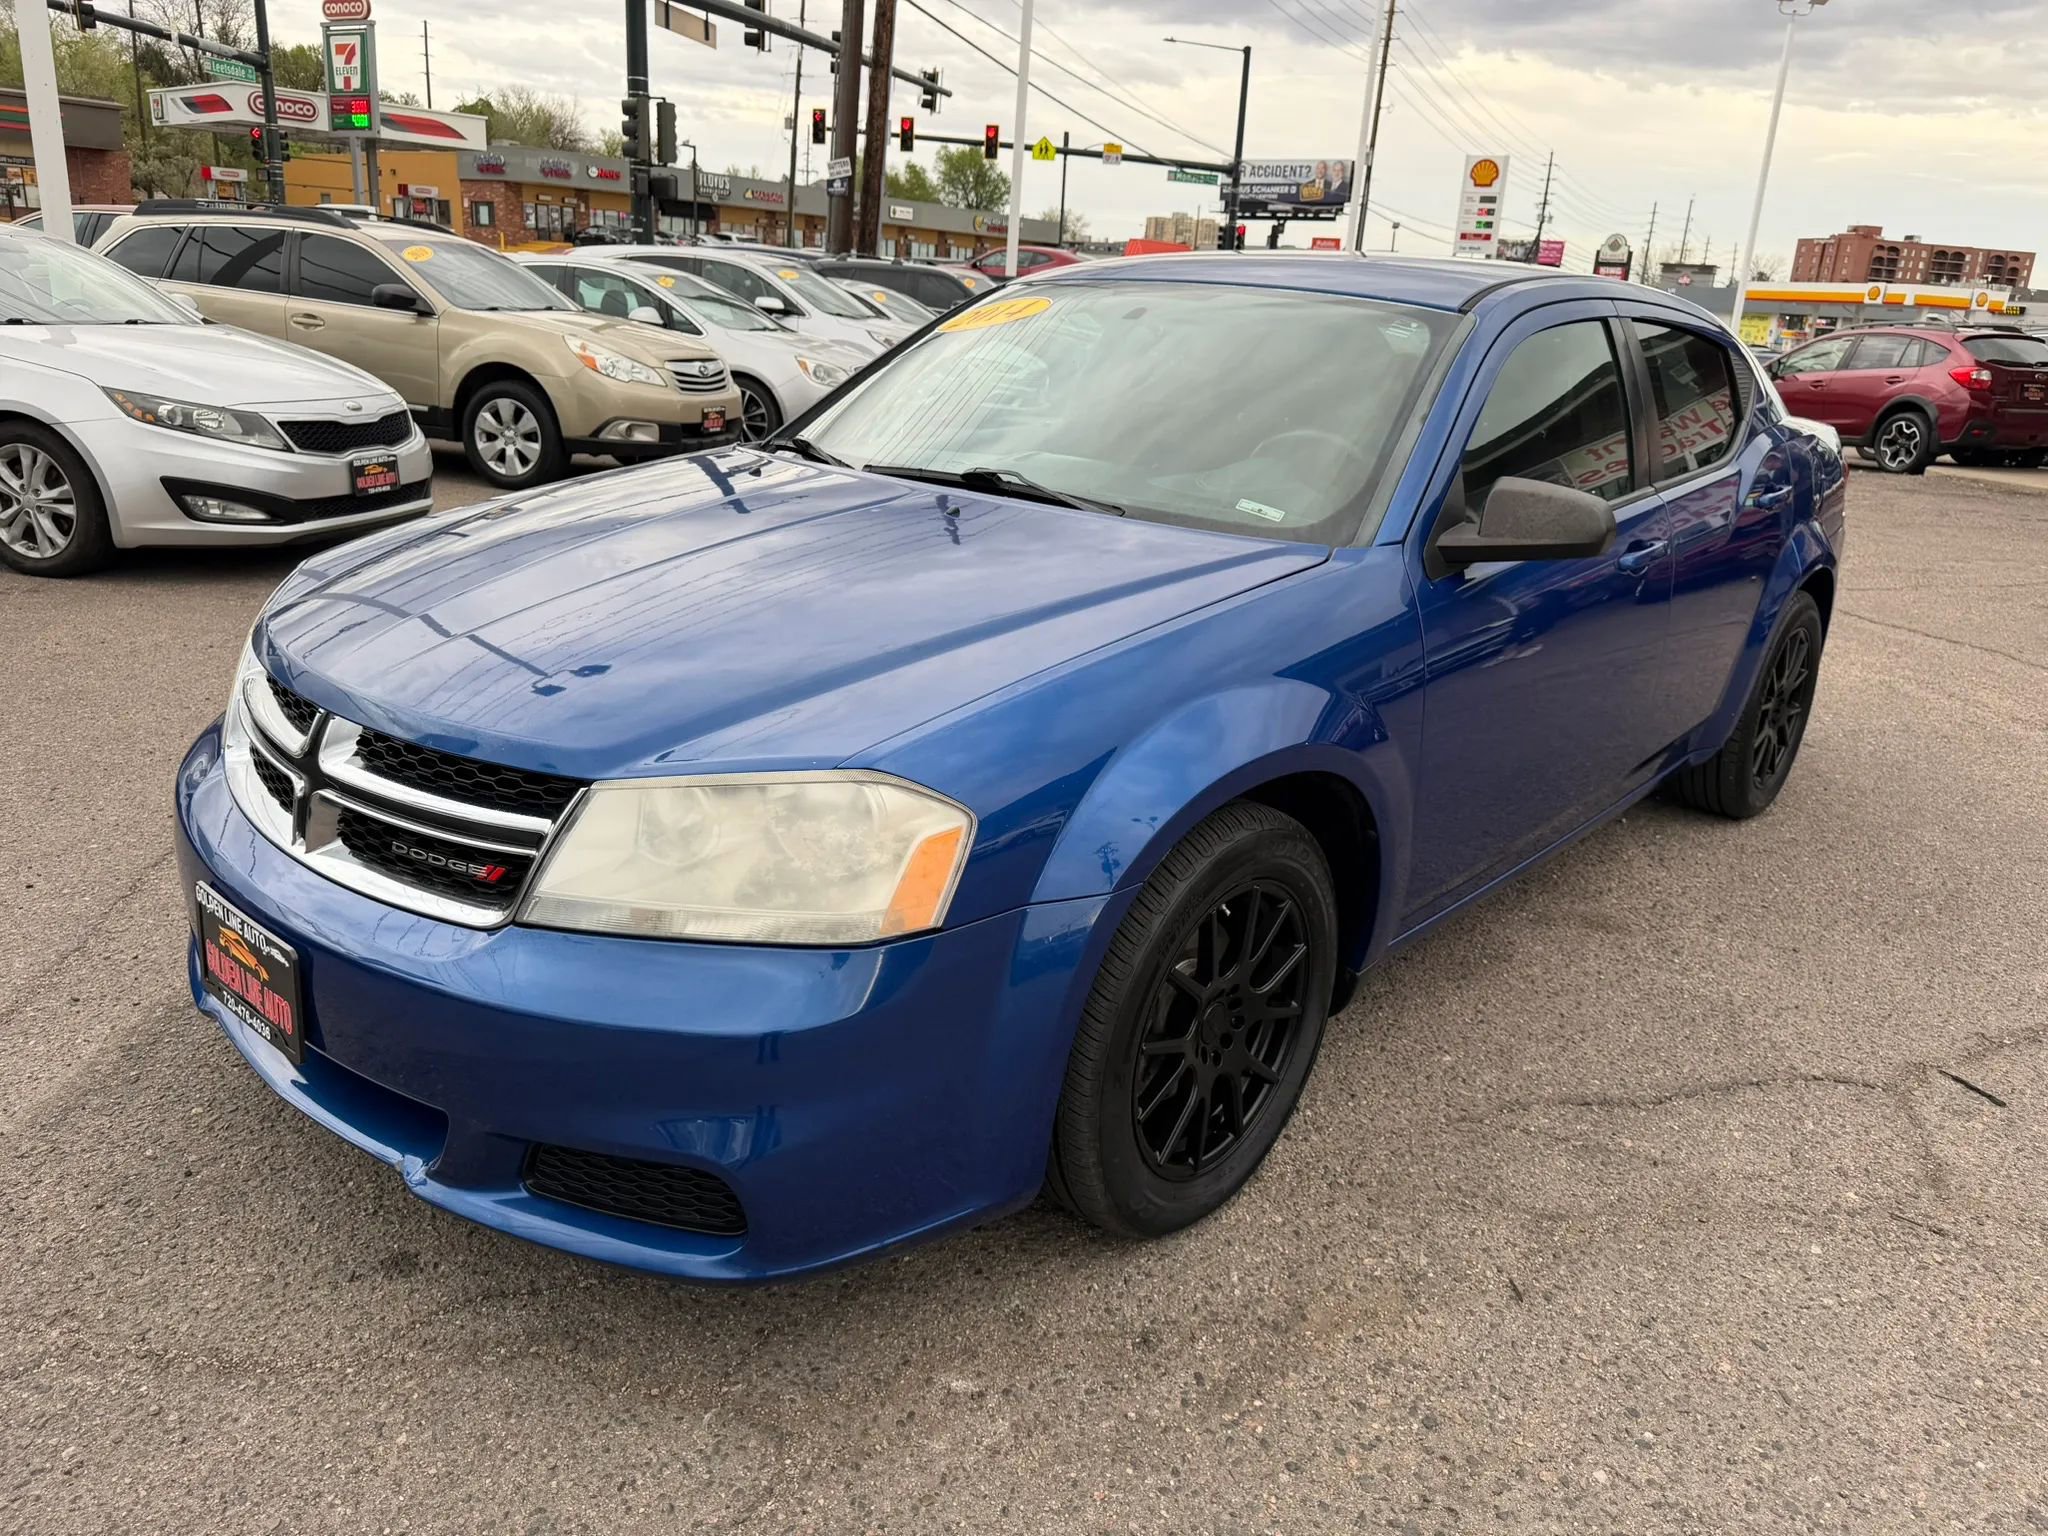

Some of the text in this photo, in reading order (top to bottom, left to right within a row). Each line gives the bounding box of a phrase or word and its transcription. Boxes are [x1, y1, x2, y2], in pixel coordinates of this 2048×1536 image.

[256, 100, 314, 116] cnoco
[1249, 165, 1312, 178] ACCIDENT?
[391, 841, 488, 877] DODGE
[195, 885, 266, 951] GOLDEN LINE AUTO
